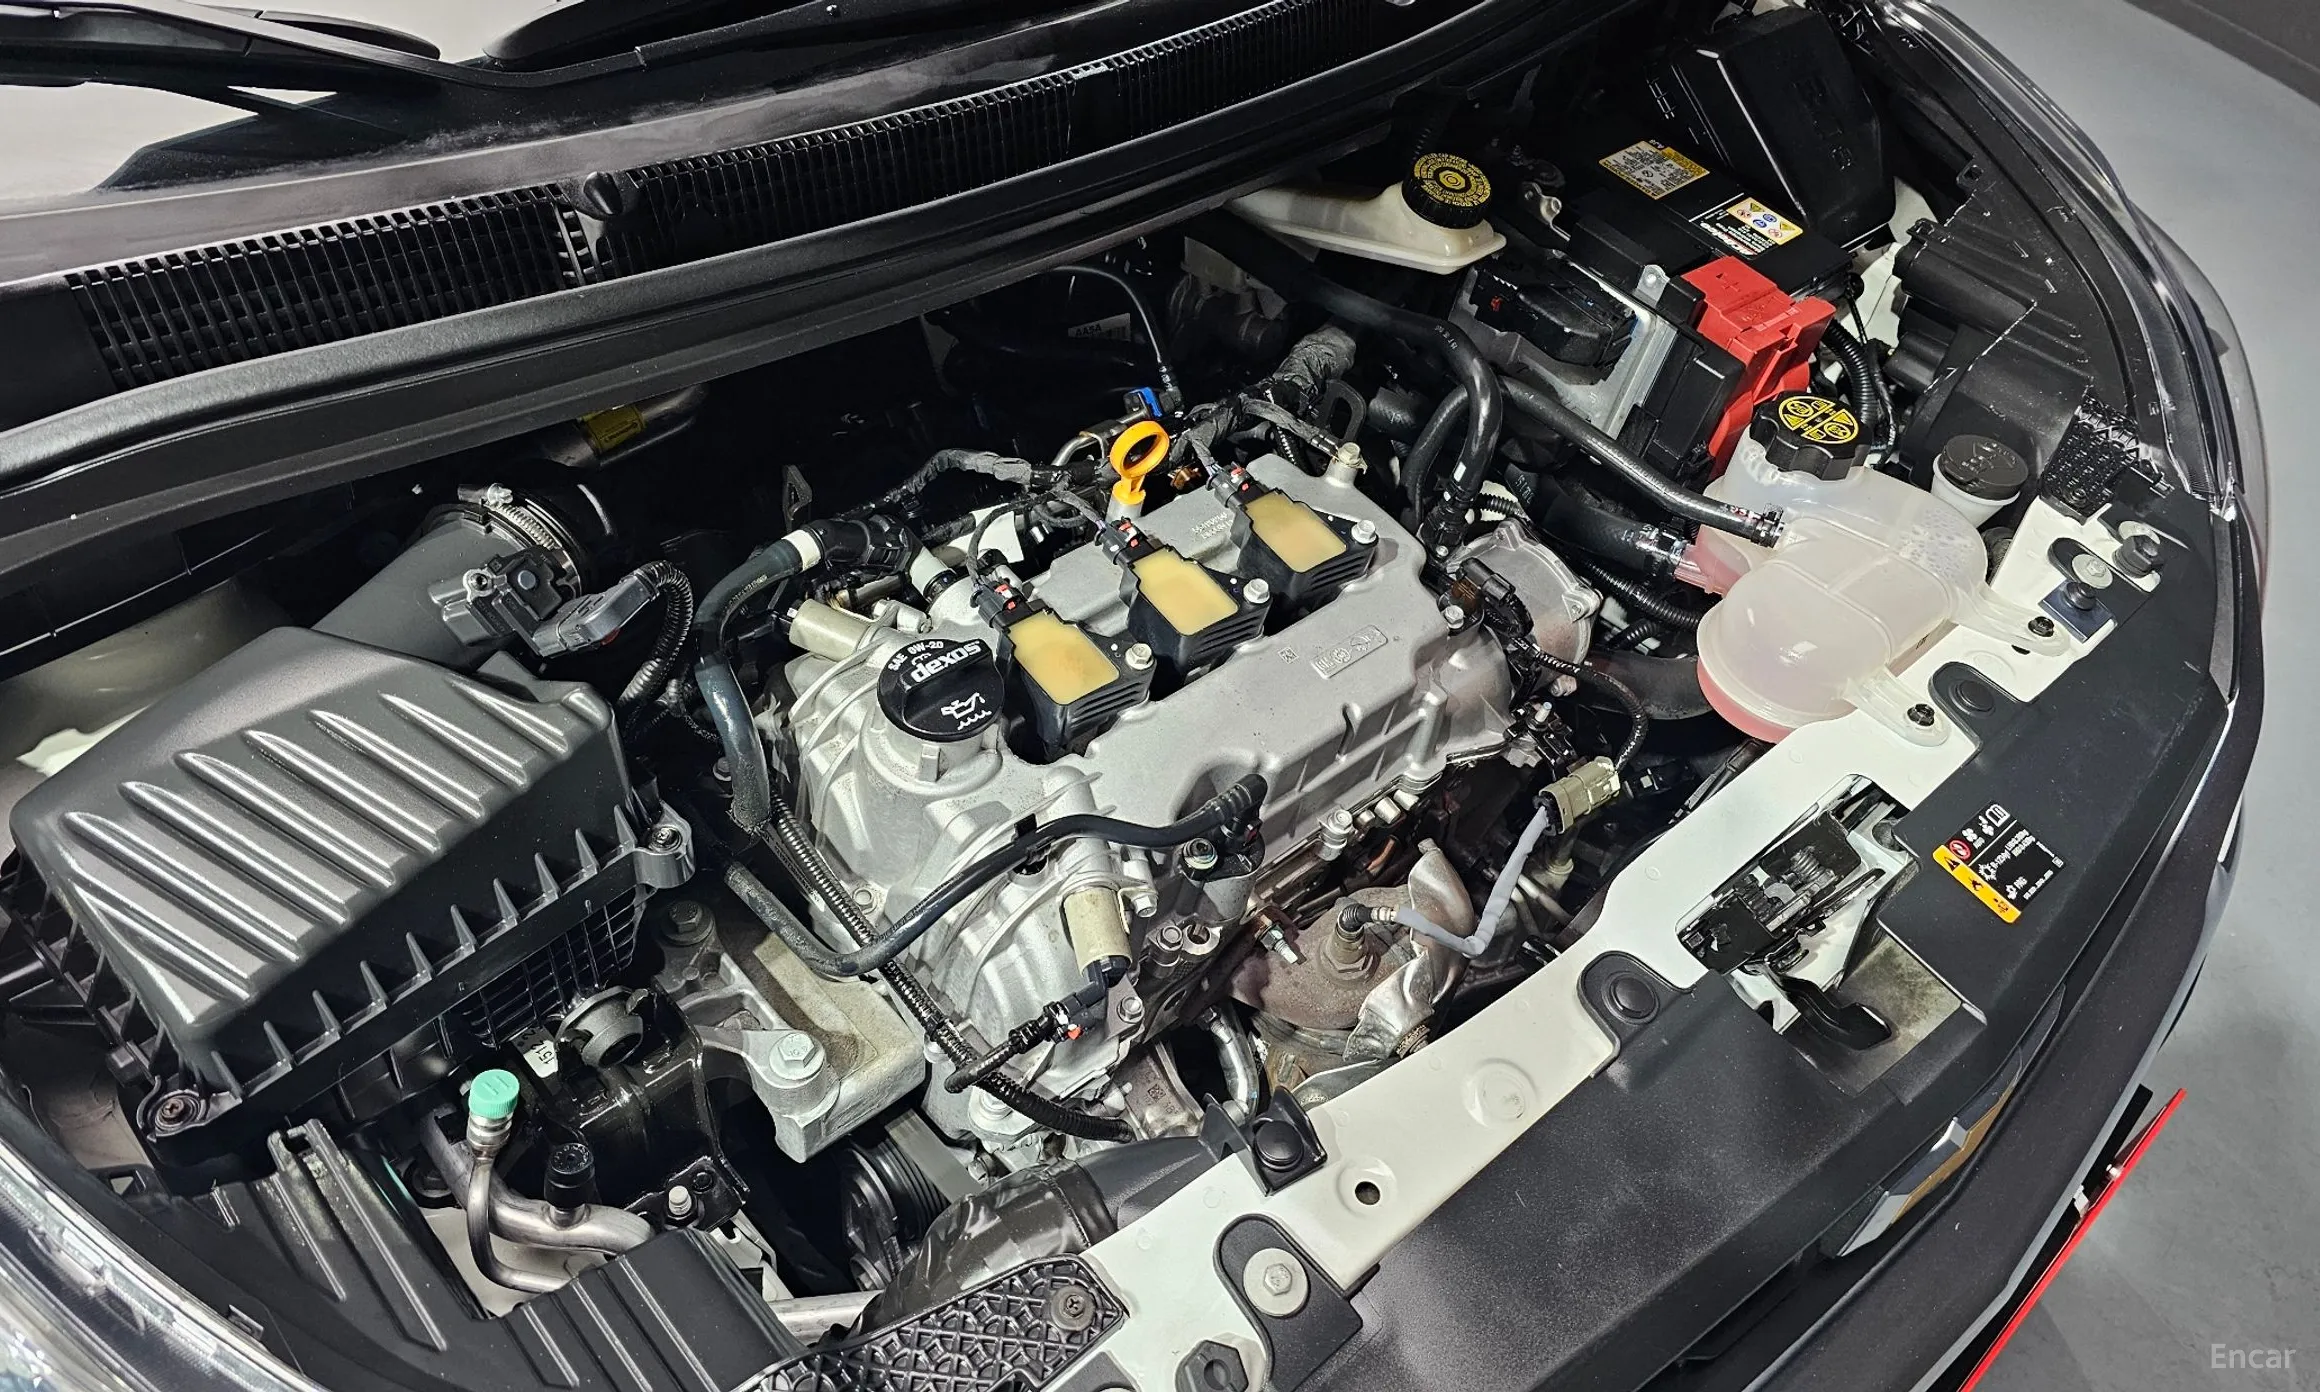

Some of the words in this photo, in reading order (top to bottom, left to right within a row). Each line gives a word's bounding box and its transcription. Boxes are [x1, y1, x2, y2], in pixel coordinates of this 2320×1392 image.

[887, 653, 909, 672] SAE
[906, 640, 945, 656] 0W-20
[910, 641, 982, 683] dexos
